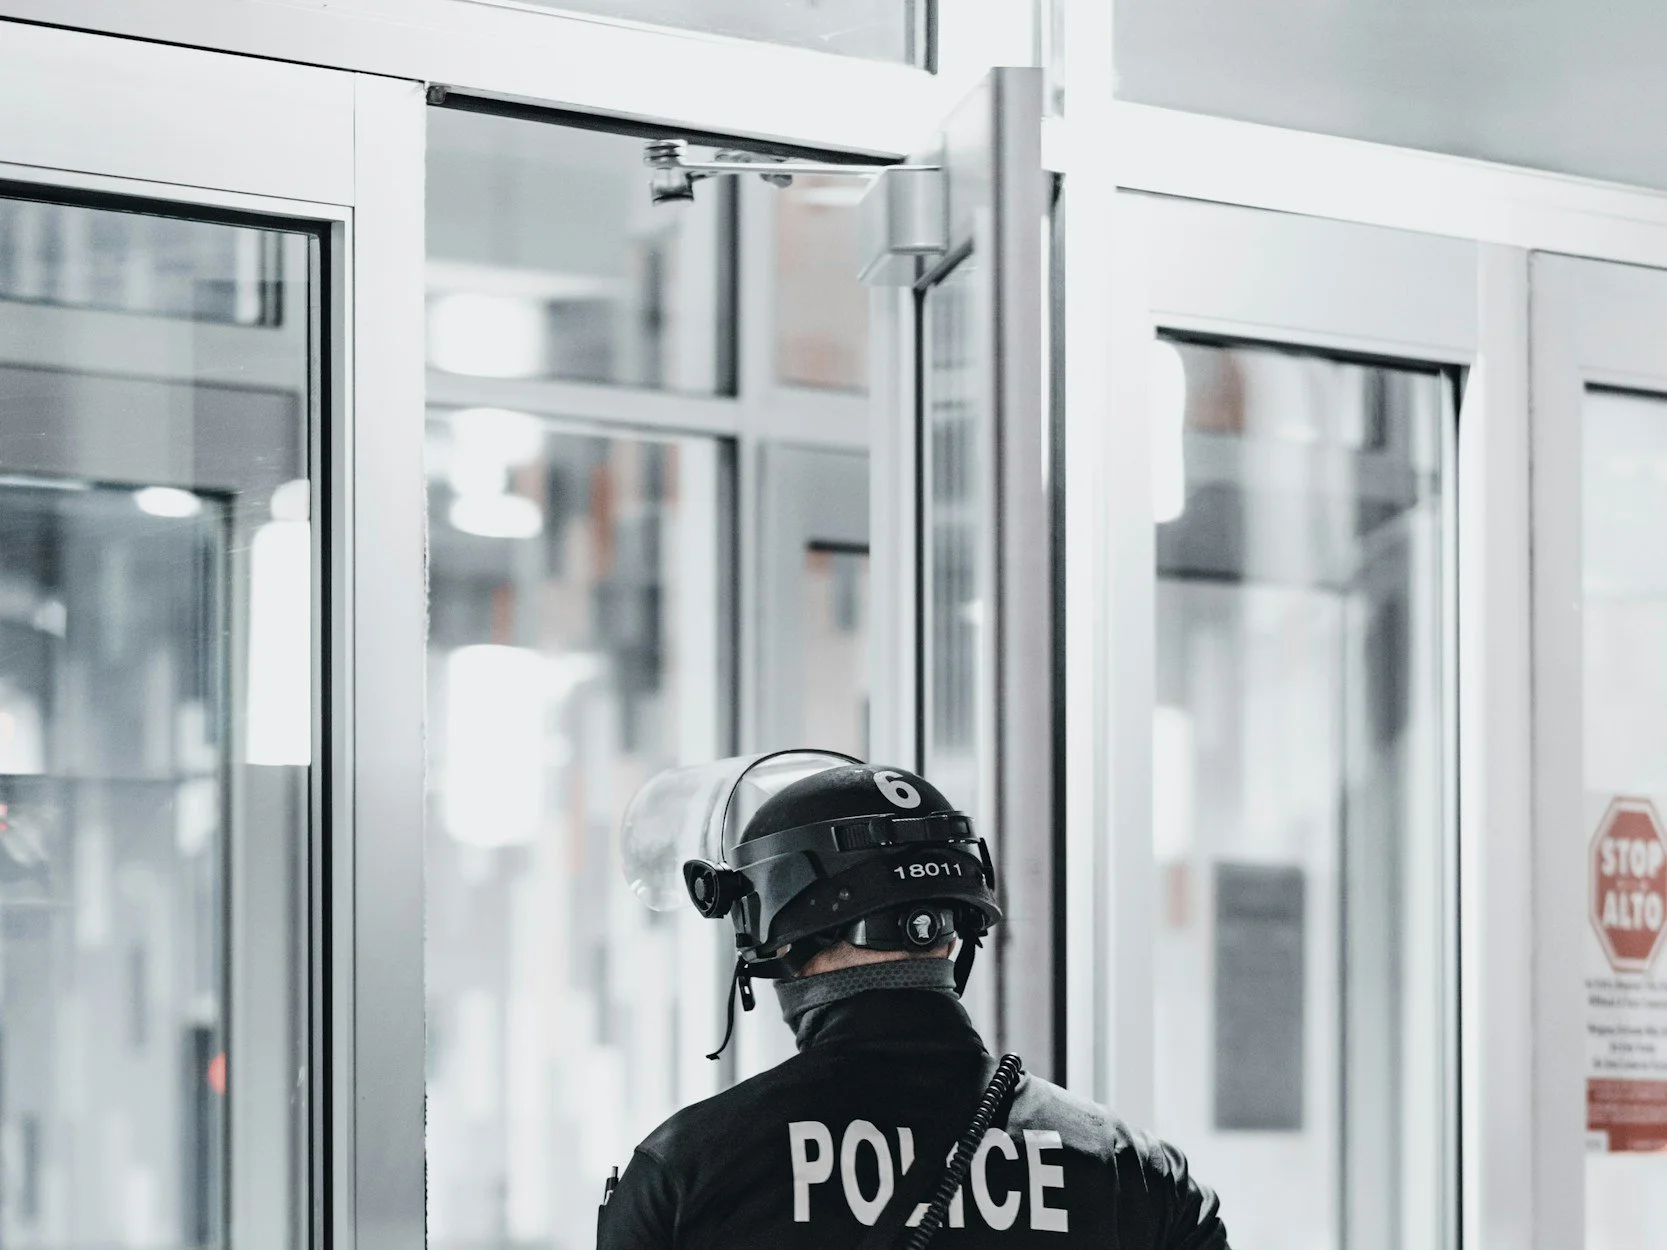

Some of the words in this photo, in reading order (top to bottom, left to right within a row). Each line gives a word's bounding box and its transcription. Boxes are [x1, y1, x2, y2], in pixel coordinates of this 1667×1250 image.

[873, 770, 921, 809] 6
[893, 862, 962, 880] 18011
[1600, 837, 1663, 879] STOP
[1601, 889, 1663, 932] ALTO
